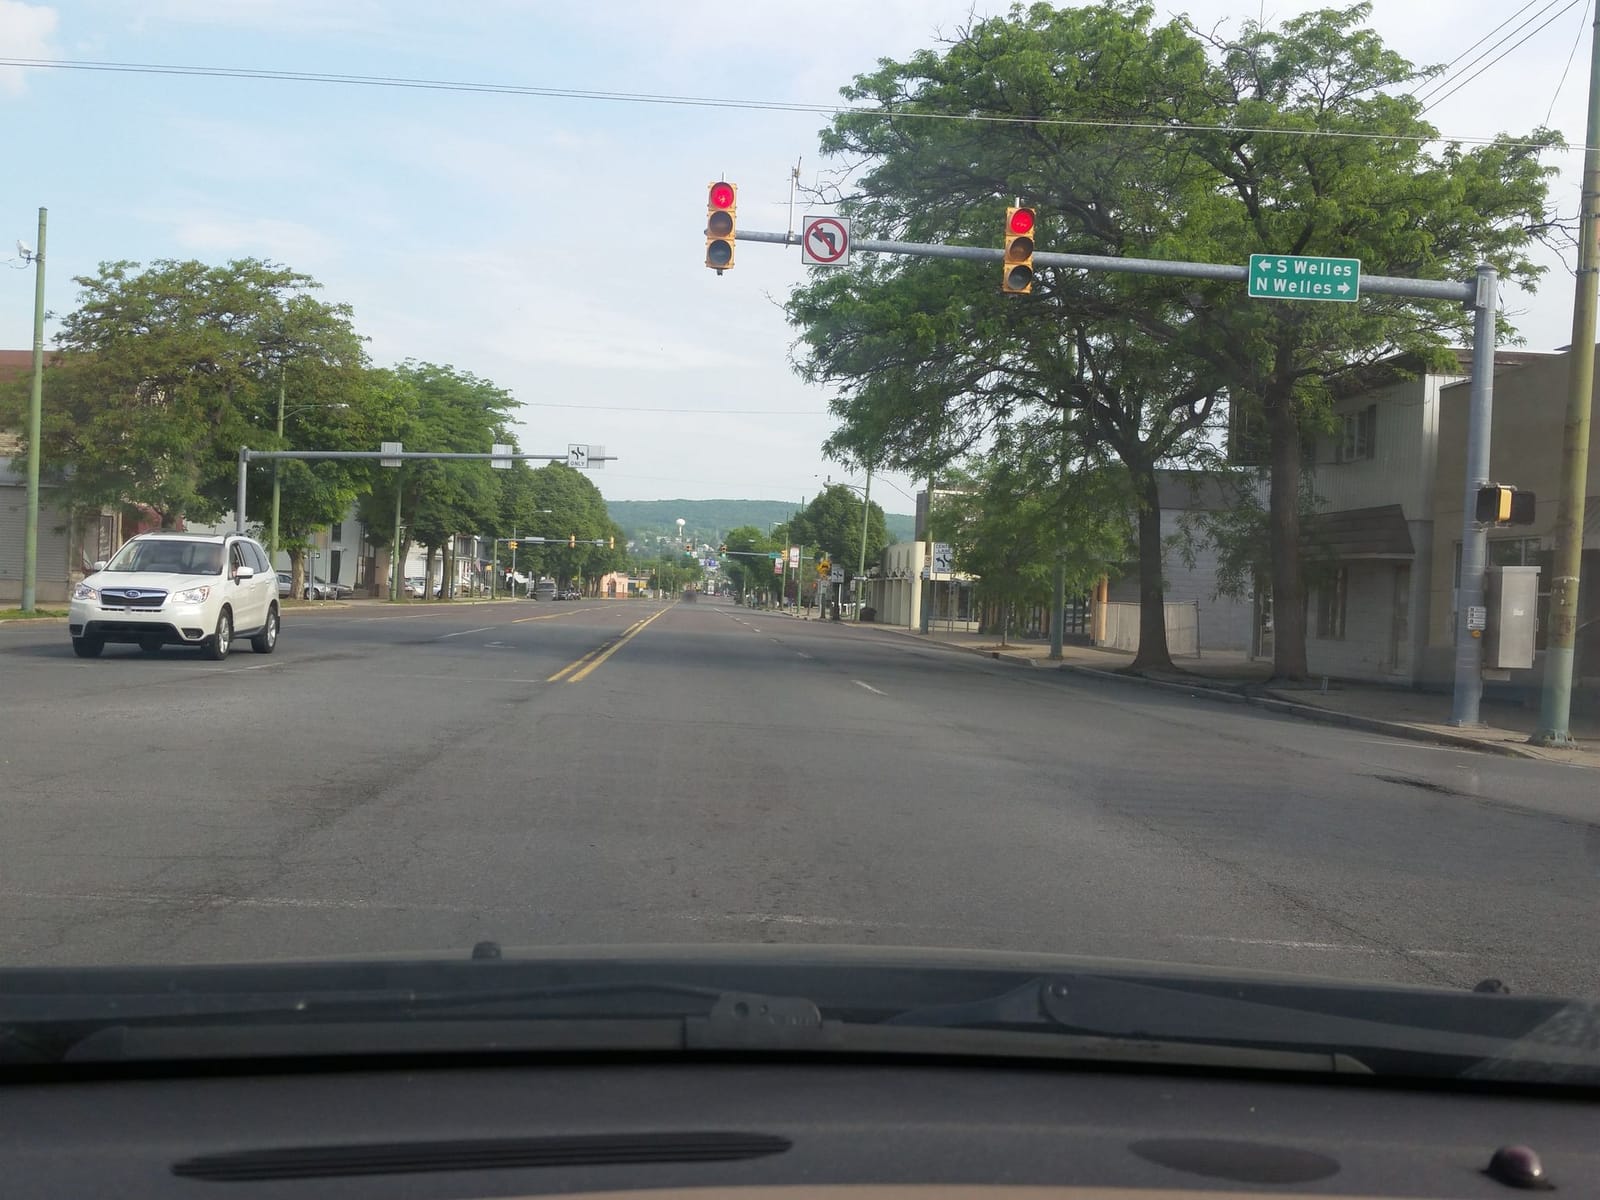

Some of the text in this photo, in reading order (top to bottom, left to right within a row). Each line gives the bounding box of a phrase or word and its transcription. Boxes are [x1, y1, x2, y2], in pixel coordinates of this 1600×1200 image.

[1277, 259, 1352, 276] S Welles
[1256, 277, 1332, 294] N Welles
